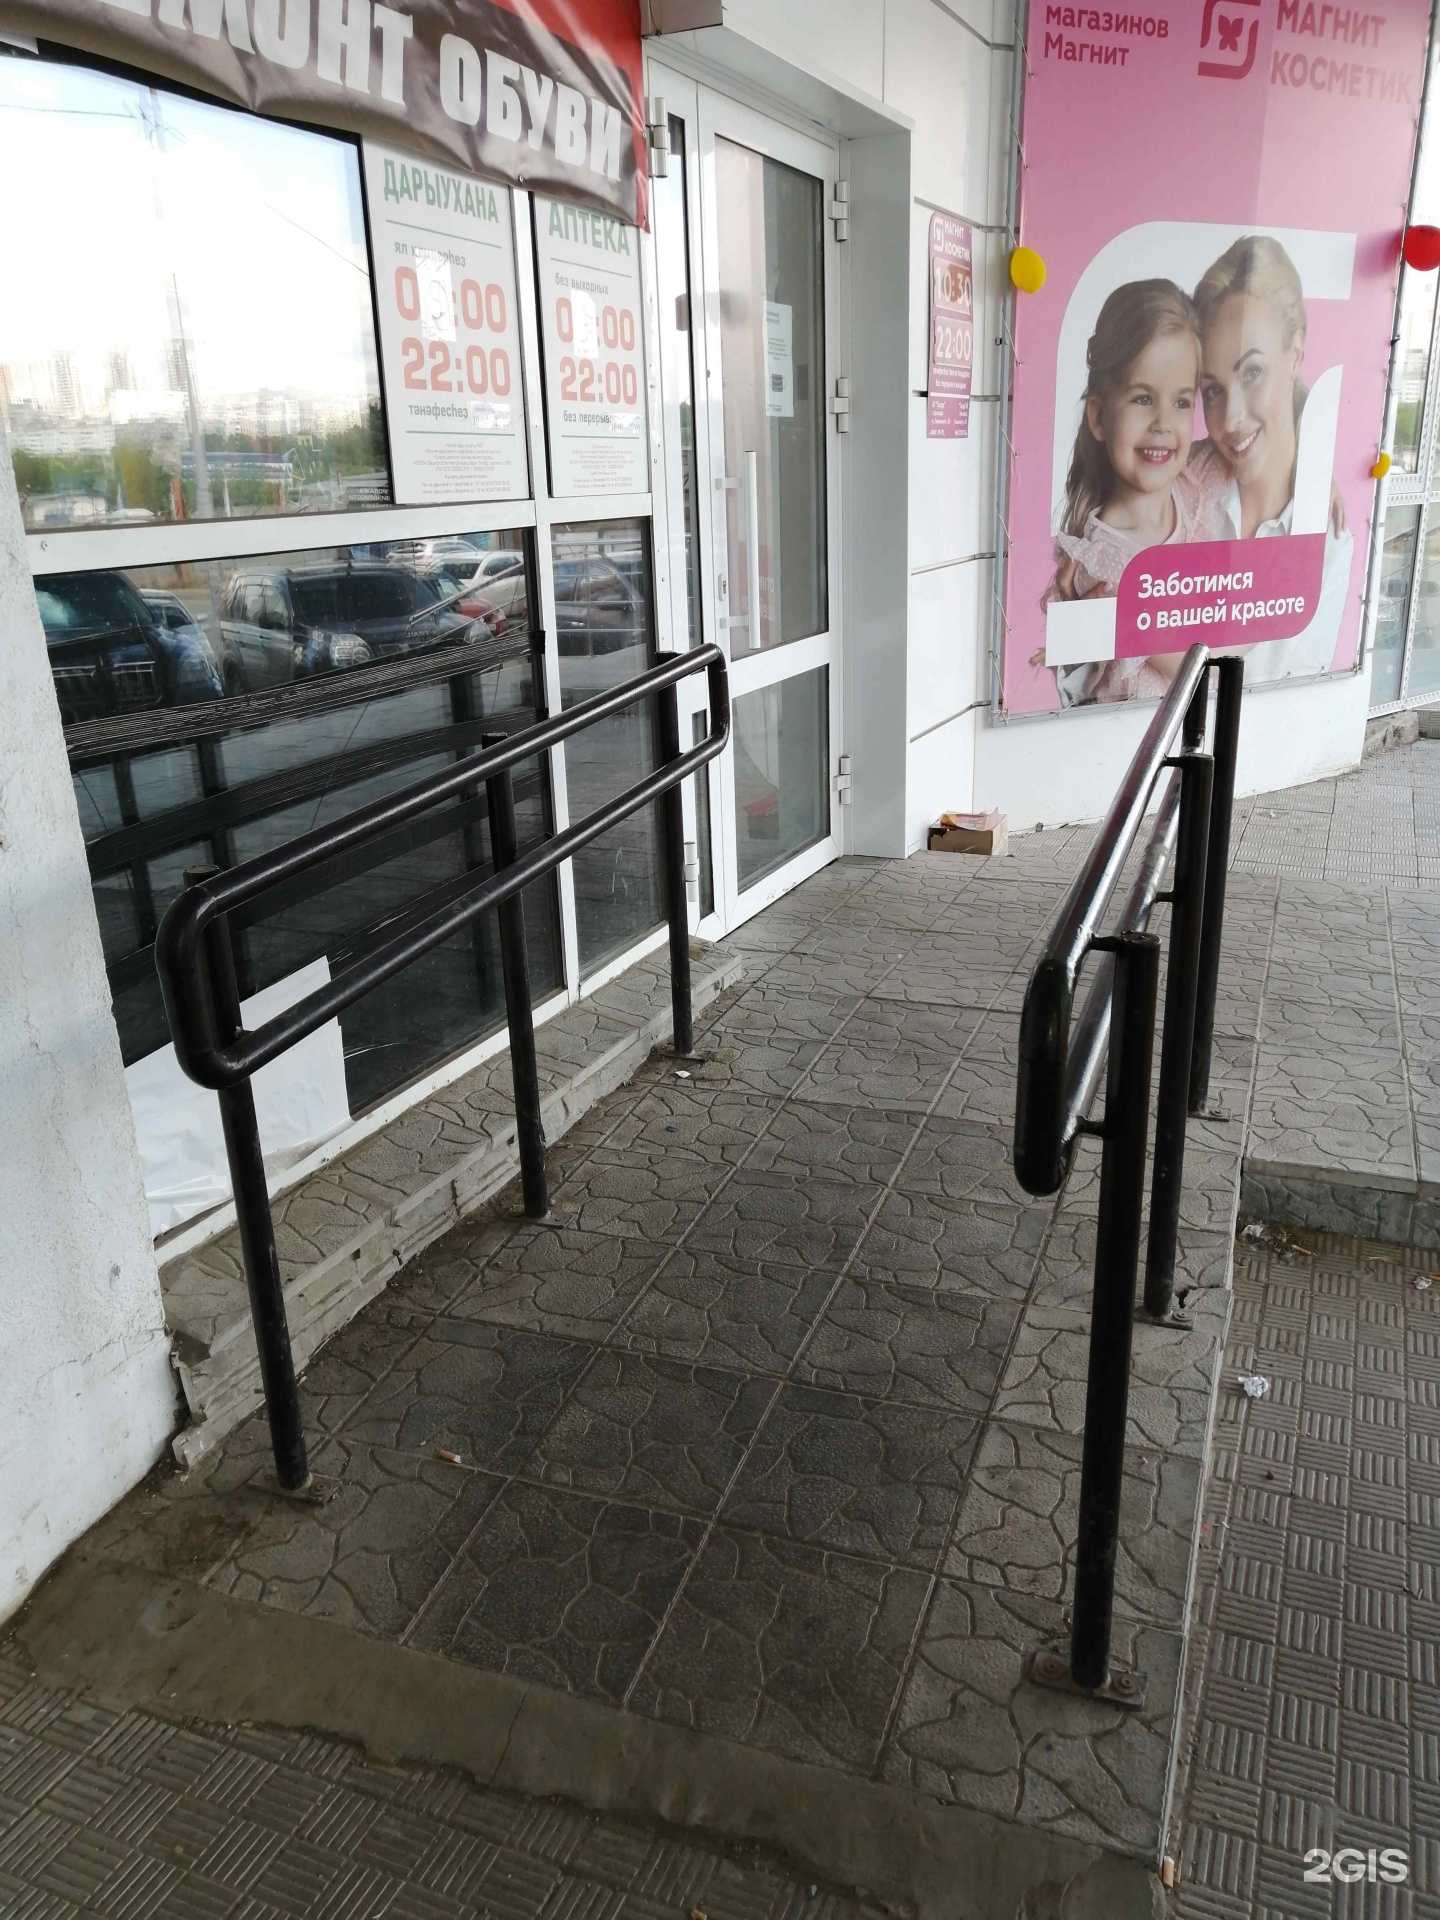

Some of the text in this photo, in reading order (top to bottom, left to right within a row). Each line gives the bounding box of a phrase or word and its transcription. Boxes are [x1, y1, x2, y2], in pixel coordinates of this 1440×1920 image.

[1045, 4, 1169, 38] магазинов
[1276, 0, 1387, 48] МАГНИТ
[1043, 31, 1130, 67] Магнит
[1270, 50, 1414, 105] КОСМЕТИК
[440, 33, 623, 182] ОБУВИ
[383, 158, 500, 223] ДАРЫУХАНА
[549, 201, 631, 257] АПТЕКА
[394, 266, 507, 333] 0:00
[936, 265, 971, 304] 10:30
[555, 297, 636, 352] 0:00
[935, 325, 971, 361] 22:00
[401, 336, 512, 397] 22:00
[559, 356, 638, 405] 22:00
[1138, 571, 1254, 599] Заботимся
[1136, 596, 1305, 631] о вашей красоте
